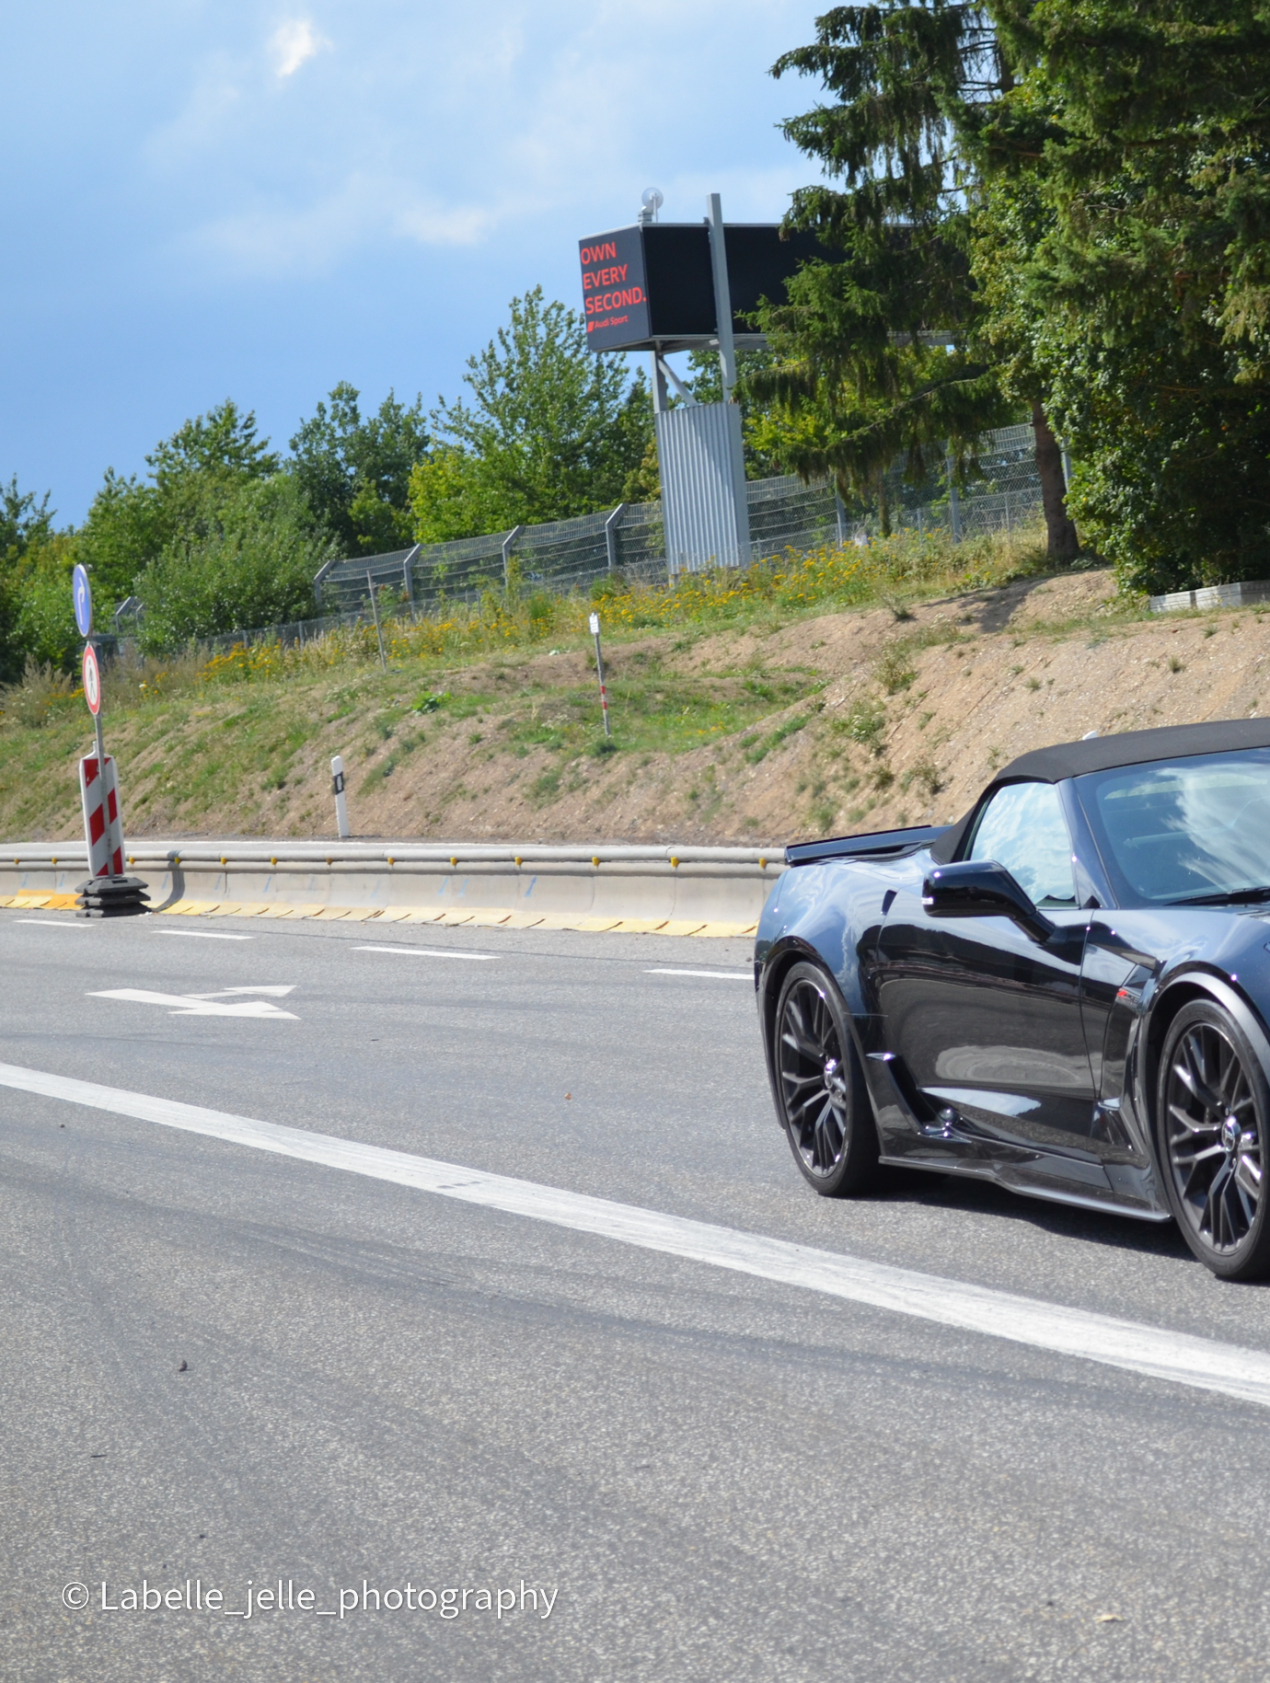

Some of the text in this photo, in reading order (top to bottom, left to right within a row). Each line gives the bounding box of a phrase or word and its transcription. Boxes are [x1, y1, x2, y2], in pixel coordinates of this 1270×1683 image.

[580, 241, 617, 265] OWN
[582, 263, 628, 290] EVERY
[585, 286, 647, 315] SECOND.
[595, 315, 629, 329] Audi Sport
